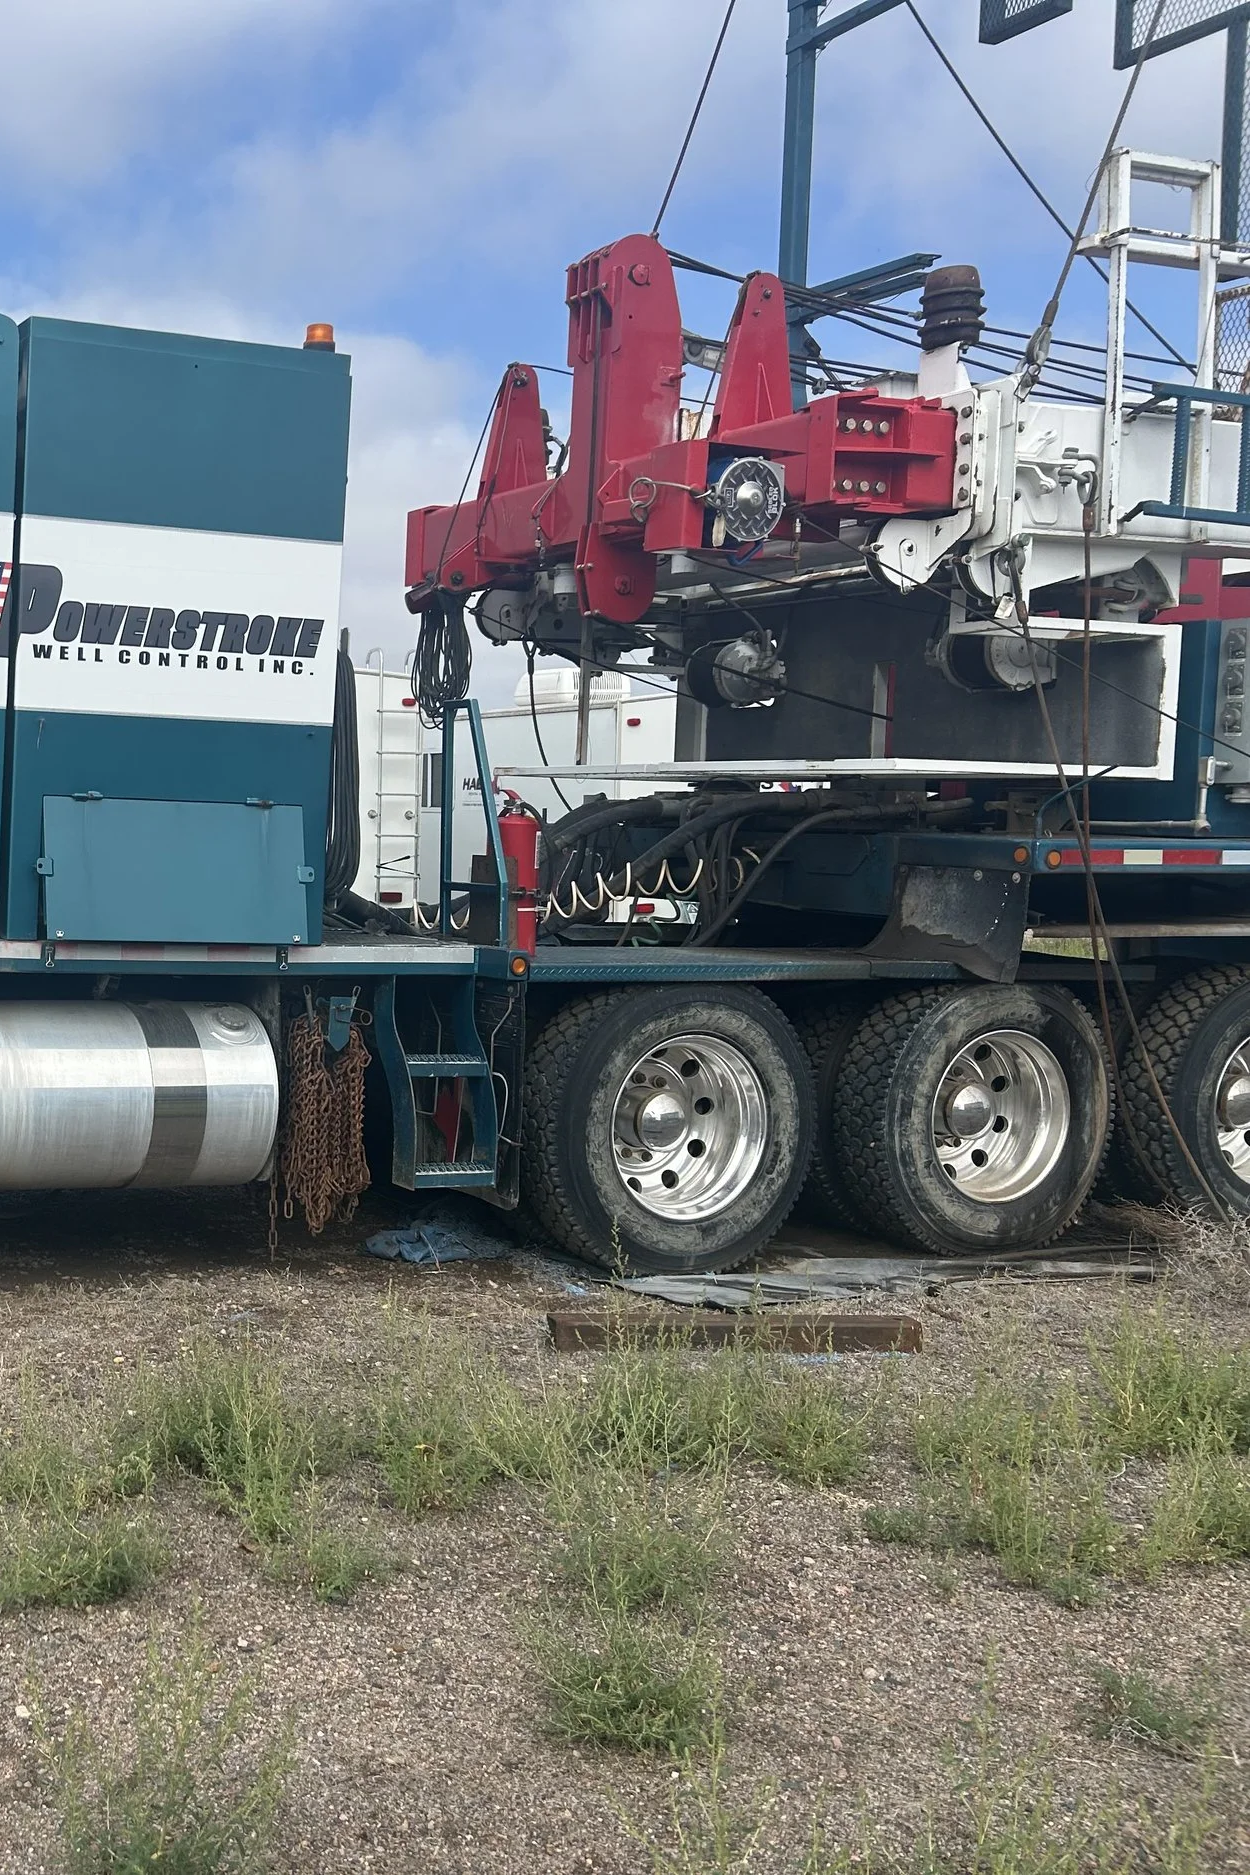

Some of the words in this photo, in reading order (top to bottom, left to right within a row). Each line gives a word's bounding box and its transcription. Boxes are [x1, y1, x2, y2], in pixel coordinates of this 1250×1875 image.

[32, 643, 104, 663] WELL
[118, 649, 244, 672] CONTROL
[258, 658, 314, 676] INC.
